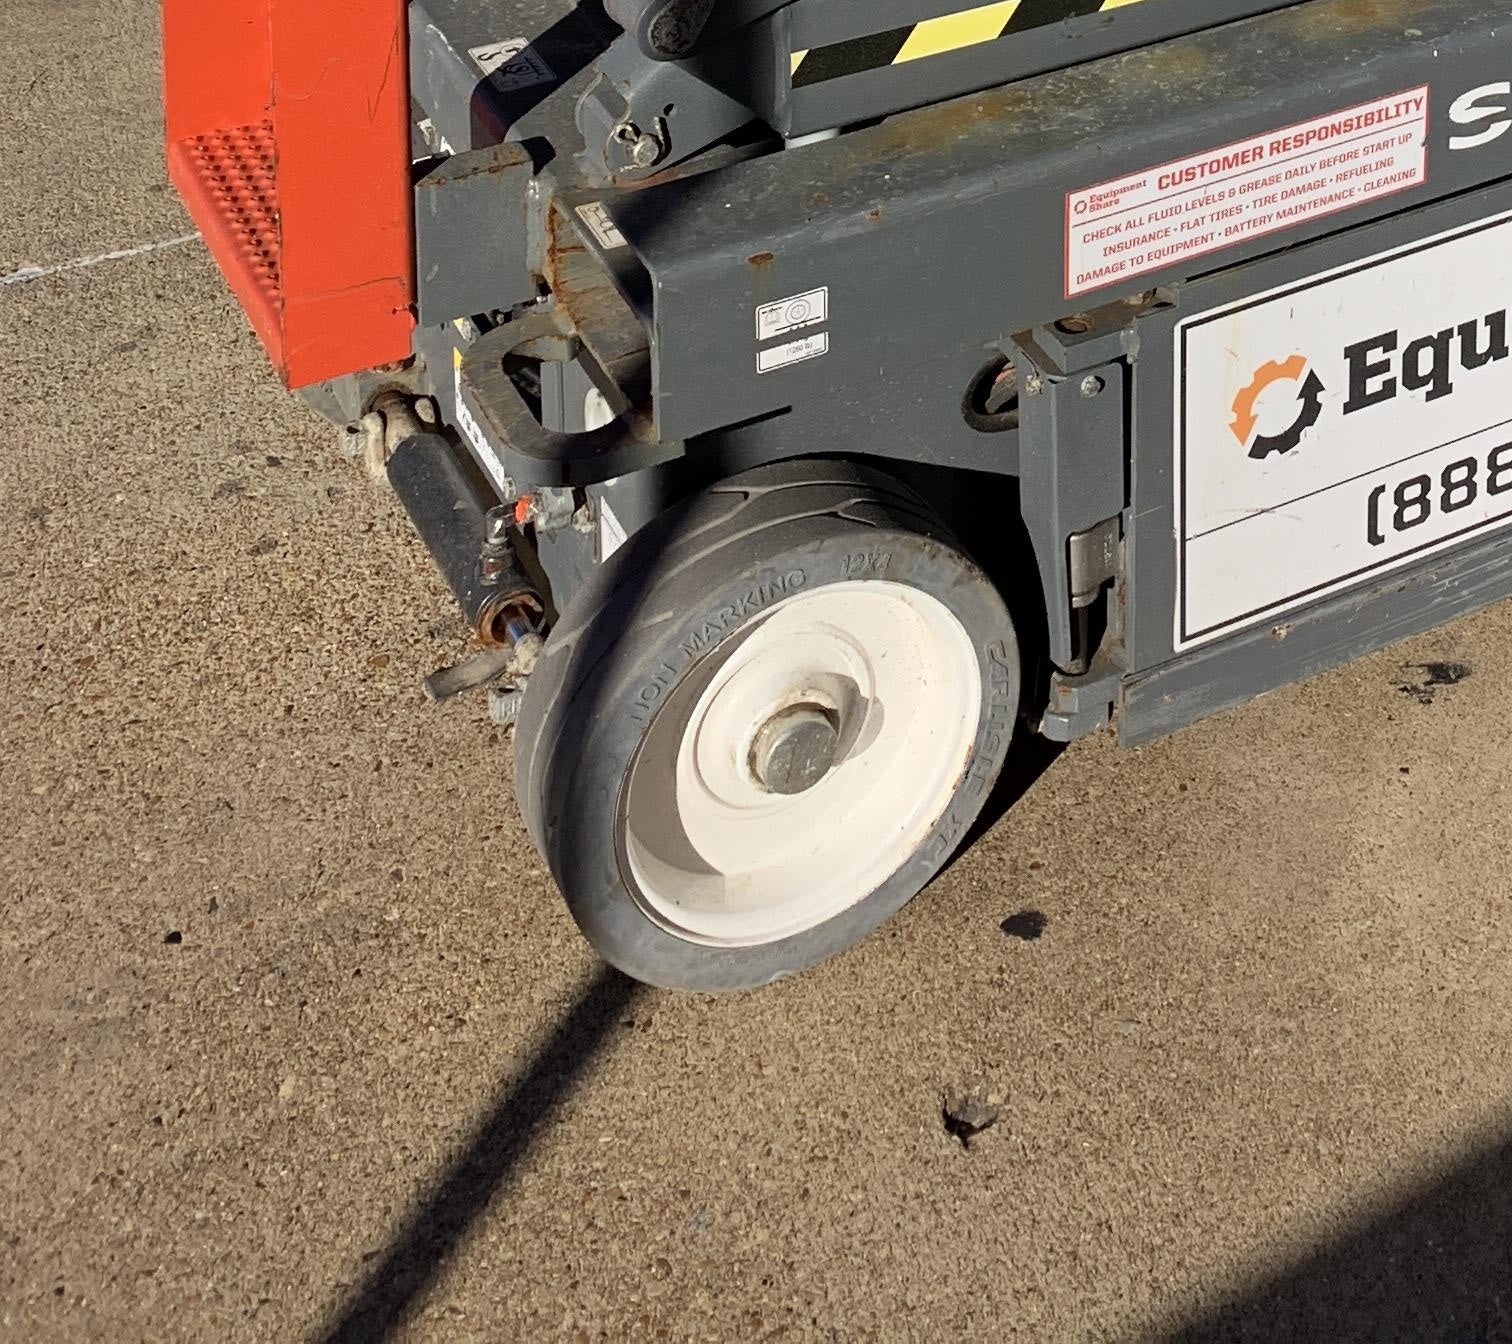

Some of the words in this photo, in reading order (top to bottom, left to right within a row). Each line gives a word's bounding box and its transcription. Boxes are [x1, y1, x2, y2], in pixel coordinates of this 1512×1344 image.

[1083, 222, 1123, 244] CHECK
[1125, 216, 1145, 231] ALL
[1148, 204, 1182, 224] FLUID
[1185, 191, 1225, 212] LEVELS
[1239, 173, 1282, 194] GREASE
[1284, 162, 1317, 180] DAILY
[1319, 148, 1360, 170] BEFORE
[1362, 140, 1395, 156] START
[1398, 132, 1413, 145] UP
[1157, 144, 1265, 190] CUSTOMER
[1269, 95, 1424, 157] RESPONSIBILITY
[1076, 260, 1126, 285] DAMAGE
[1129, 254, 1144, 267] TO
[1147, 231, 1216, 263] EQUIPMENT
[1224, 214, 1278, 237] BATTERY
[1276, 186, 1356, 221] MAINTENANCE
[1363, 167, 1417, 192] CLEANING
[1089, 179, 1148, 204] Equipment
[1089, 197, 1120, 213] Share
[1103, 226, 1171, 257] INSURANCE
[1180, 215, 1206, 232] FLAT
[1209, 204, 1243, 221] TIRES
[1252, 193, 1278, 209] TIRE
[1281, 178, 1327, 201] DAMAGE
[1335, 156, 1395, 183] REFUELING
[679, 568, 808, 659] MARKING
